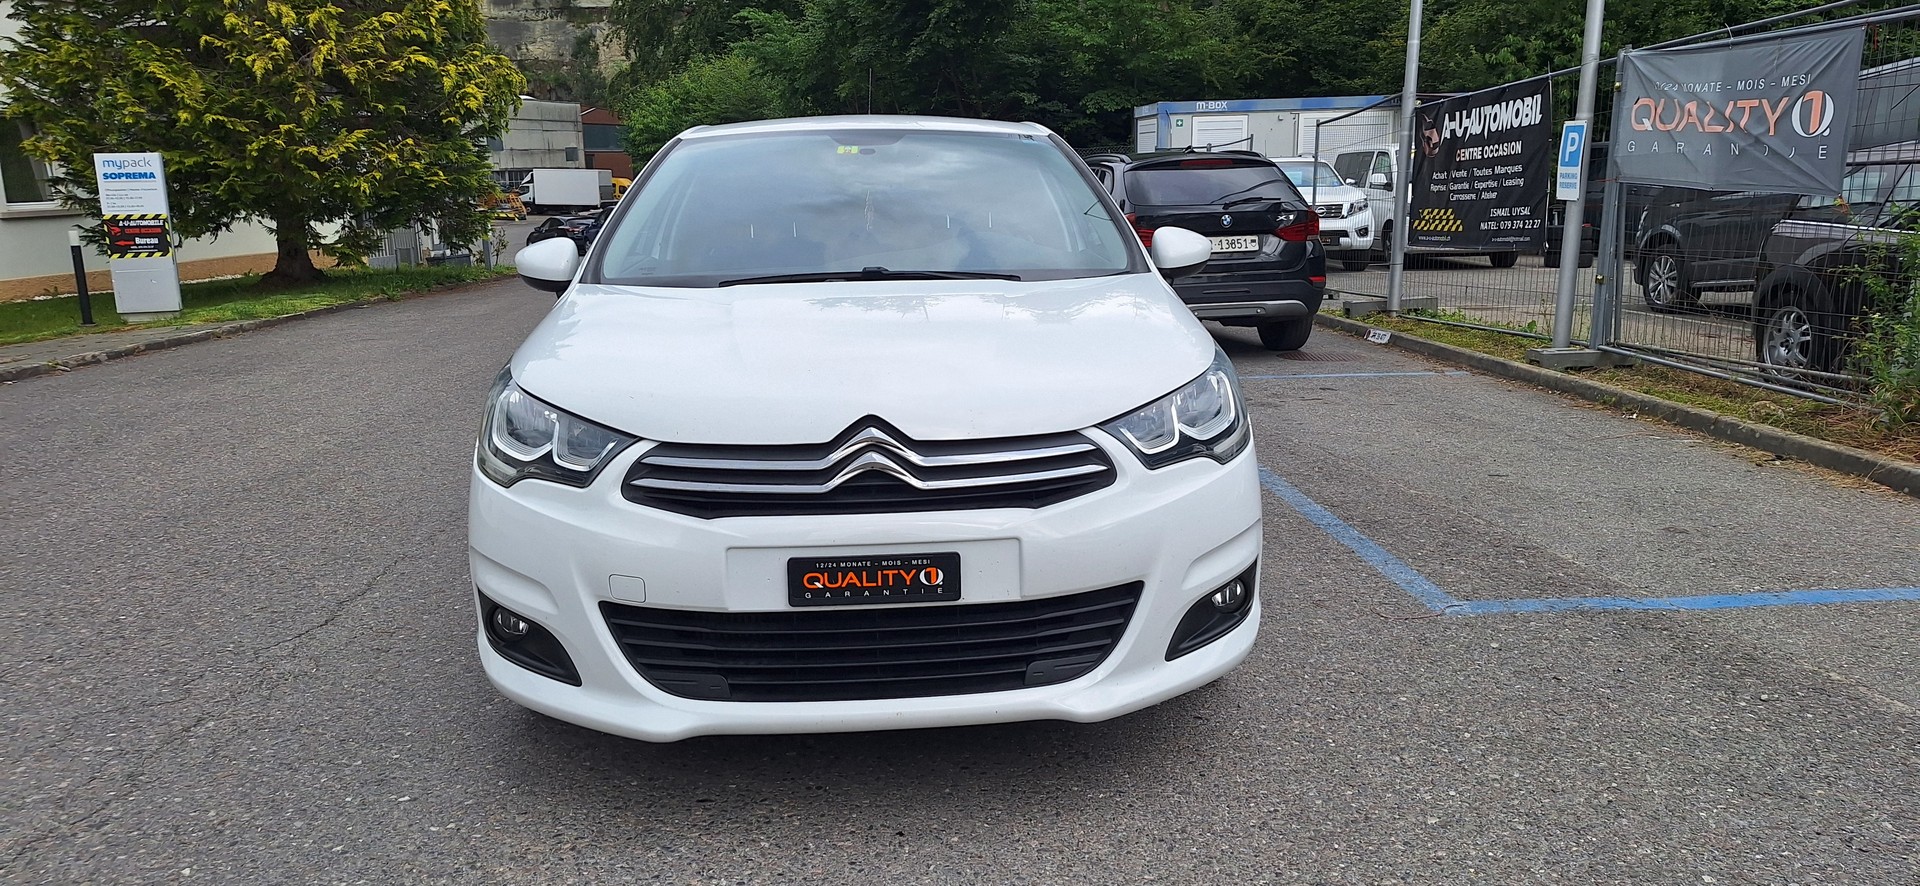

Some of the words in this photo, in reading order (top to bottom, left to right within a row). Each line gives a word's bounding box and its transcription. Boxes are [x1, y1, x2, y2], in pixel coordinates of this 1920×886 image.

[1737, 79, 1765, 91] MOIS
[1781, 73, 1812, 87] MESI
[1630, 96, 1790, 136] QUALITY
[1455, 146, 1482, 161] CENTRE
[1483, 140, 1522, 159] OCCASION
[1564, 132, 1580, 162] P
[103, 157, 152, 169] mypack
[103, 172, 156, 180] SOPREMA
[1432, 170, 1447, 180] Achat
[1473, 167, 1493, 177] Toutes
[1494, 164, 1522, 175] Marques
[1430, 183, 1446, 193] Reprise
[1449, 181, 1470, 190] Garantie
[1474, 179, 1498, 190] Expertise
[1502, 176, 1524, 187] Leasing
[1449, 192, 1476, 201] Carrosserie
[1481, 191, 1498, 200] Atelier
[1489, 208, 1511, 217] ISMAIL
[1512, 206, 1531, 216] UYSAL
[1480, 221, 1499, 231] NATEL:
[1500, 220, 1511, 230] 079
[1512, 220, 1523, 229] 374
[1525, 220, 1532, 229] 22
[1533, 219, 1541, 229] 27
[135, 237, 159, 245] Bureau
[840, 560, 871, 568] MONATE
[803, 569, 917, 589] QUALITY
[805, 587, 943, 599] GARANTIE
